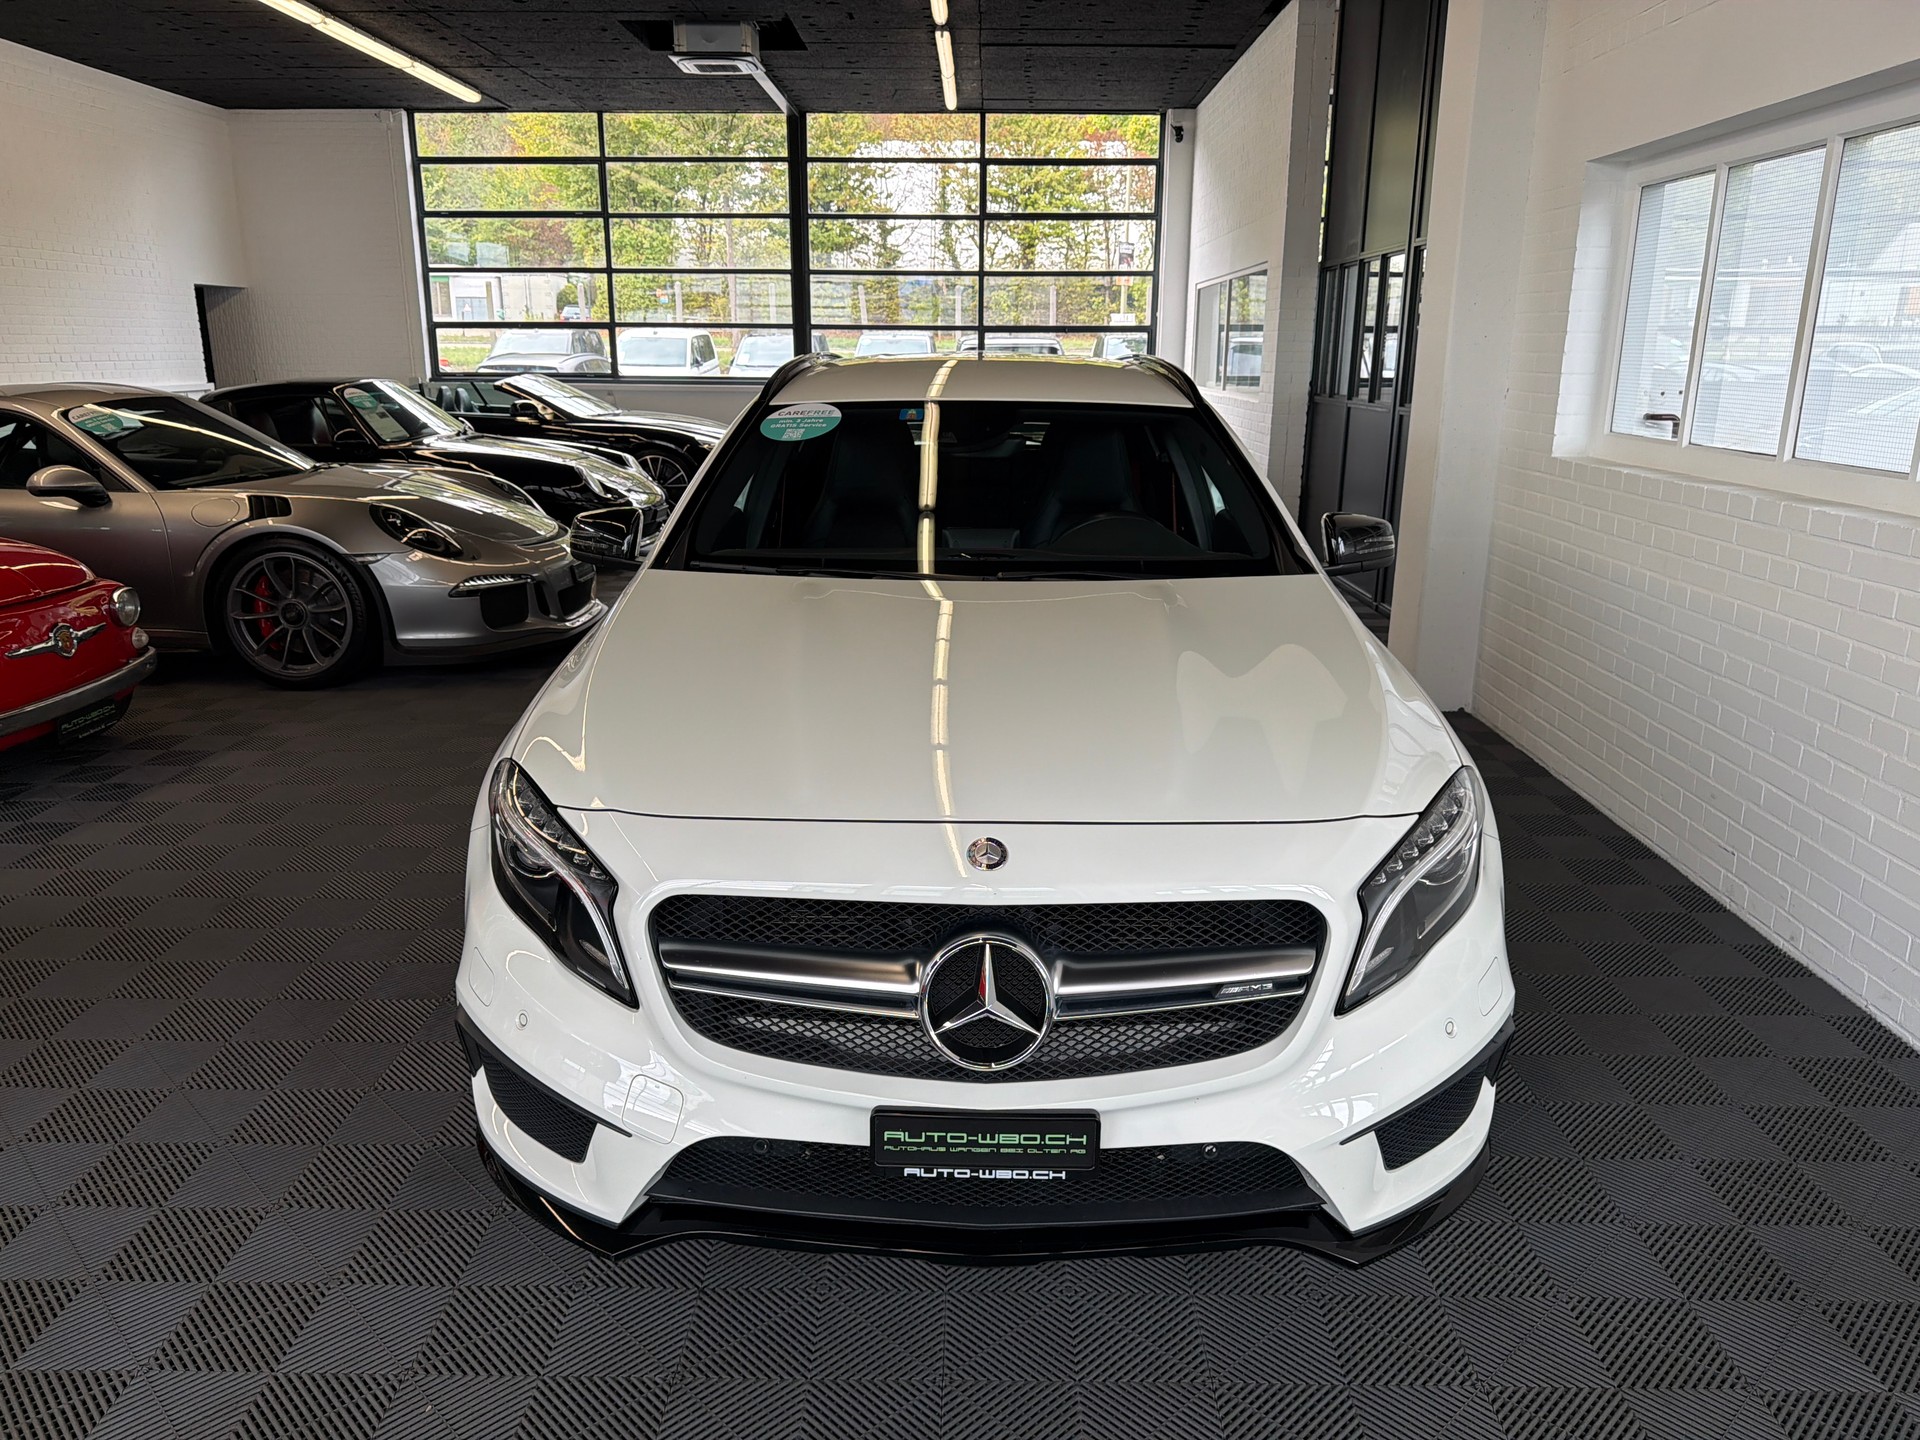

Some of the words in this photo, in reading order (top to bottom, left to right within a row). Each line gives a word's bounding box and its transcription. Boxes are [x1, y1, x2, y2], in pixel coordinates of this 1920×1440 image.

[778, 409, 836, 417] CAREFREE
[884, 1131, 1087, 1145] AUTO-WBO.CH
[903, 1167, 1066, 1180] AUTO-WBO.CH
